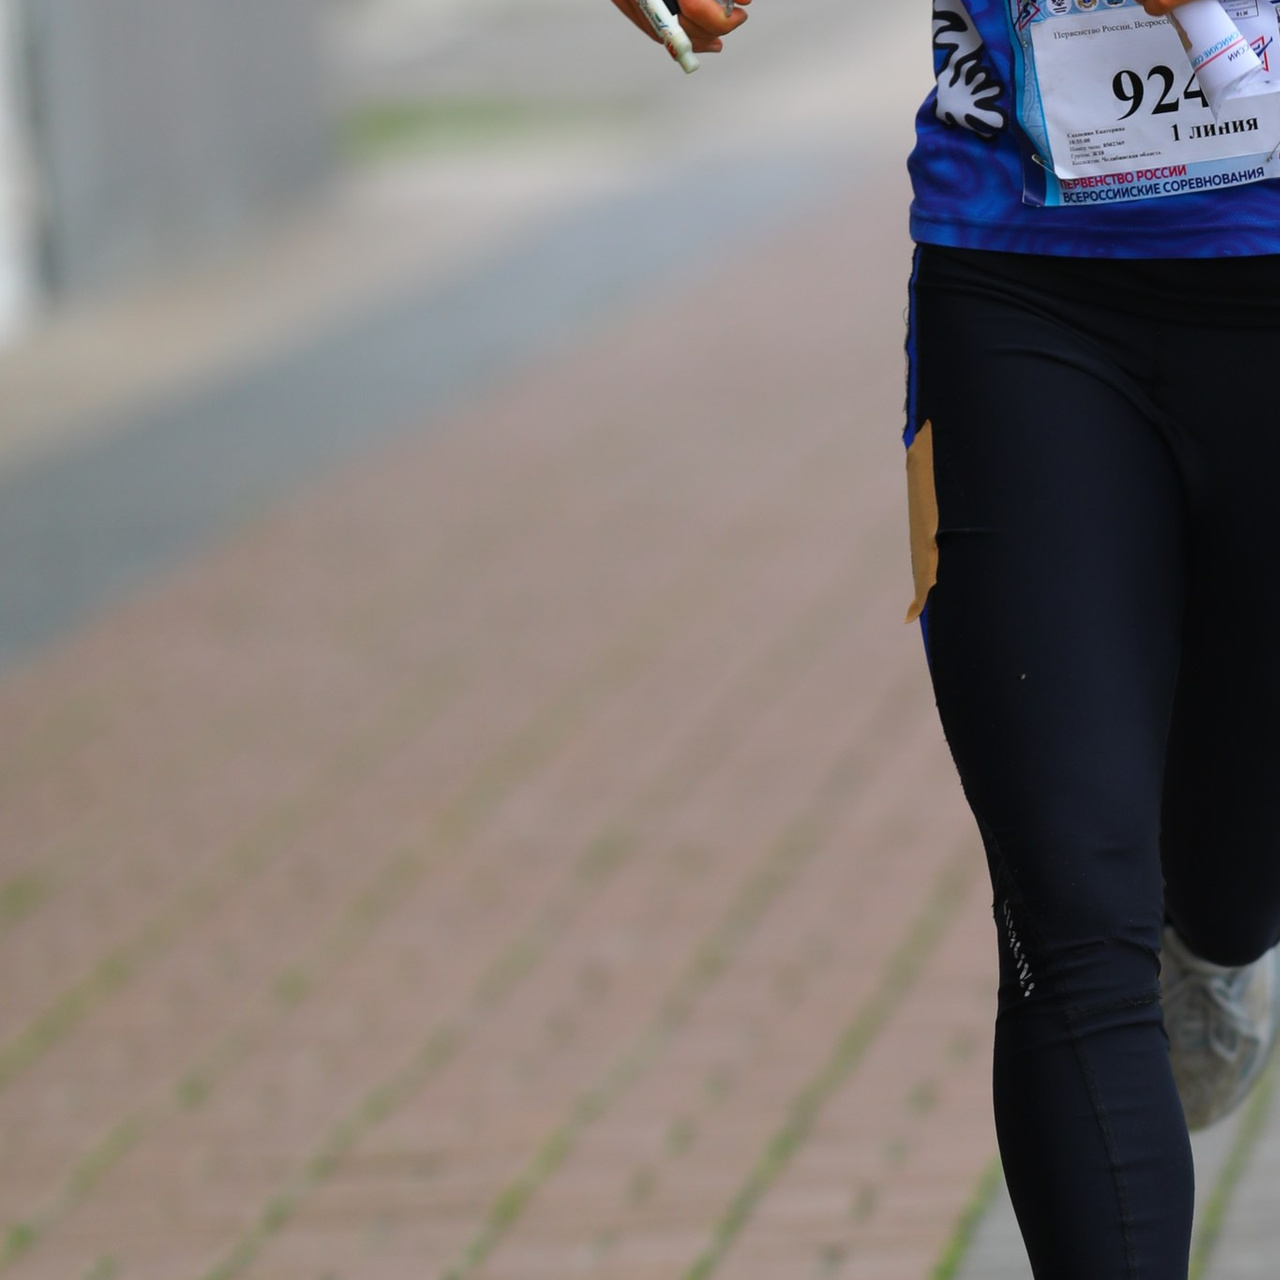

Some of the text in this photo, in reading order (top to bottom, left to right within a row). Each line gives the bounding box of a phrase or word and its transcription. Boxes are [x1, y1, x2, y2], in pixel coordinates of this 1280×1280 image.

[1053, 27, 1101, 41] Первенство
[1112, 65, 1210, 121] 924
[1170, 118, 1259, 142] 1 линия
[1136, 164, 1187, 181] РОССИИ
[1163, 167, 1265, 193] СОРЕВНОВАНИЯ
